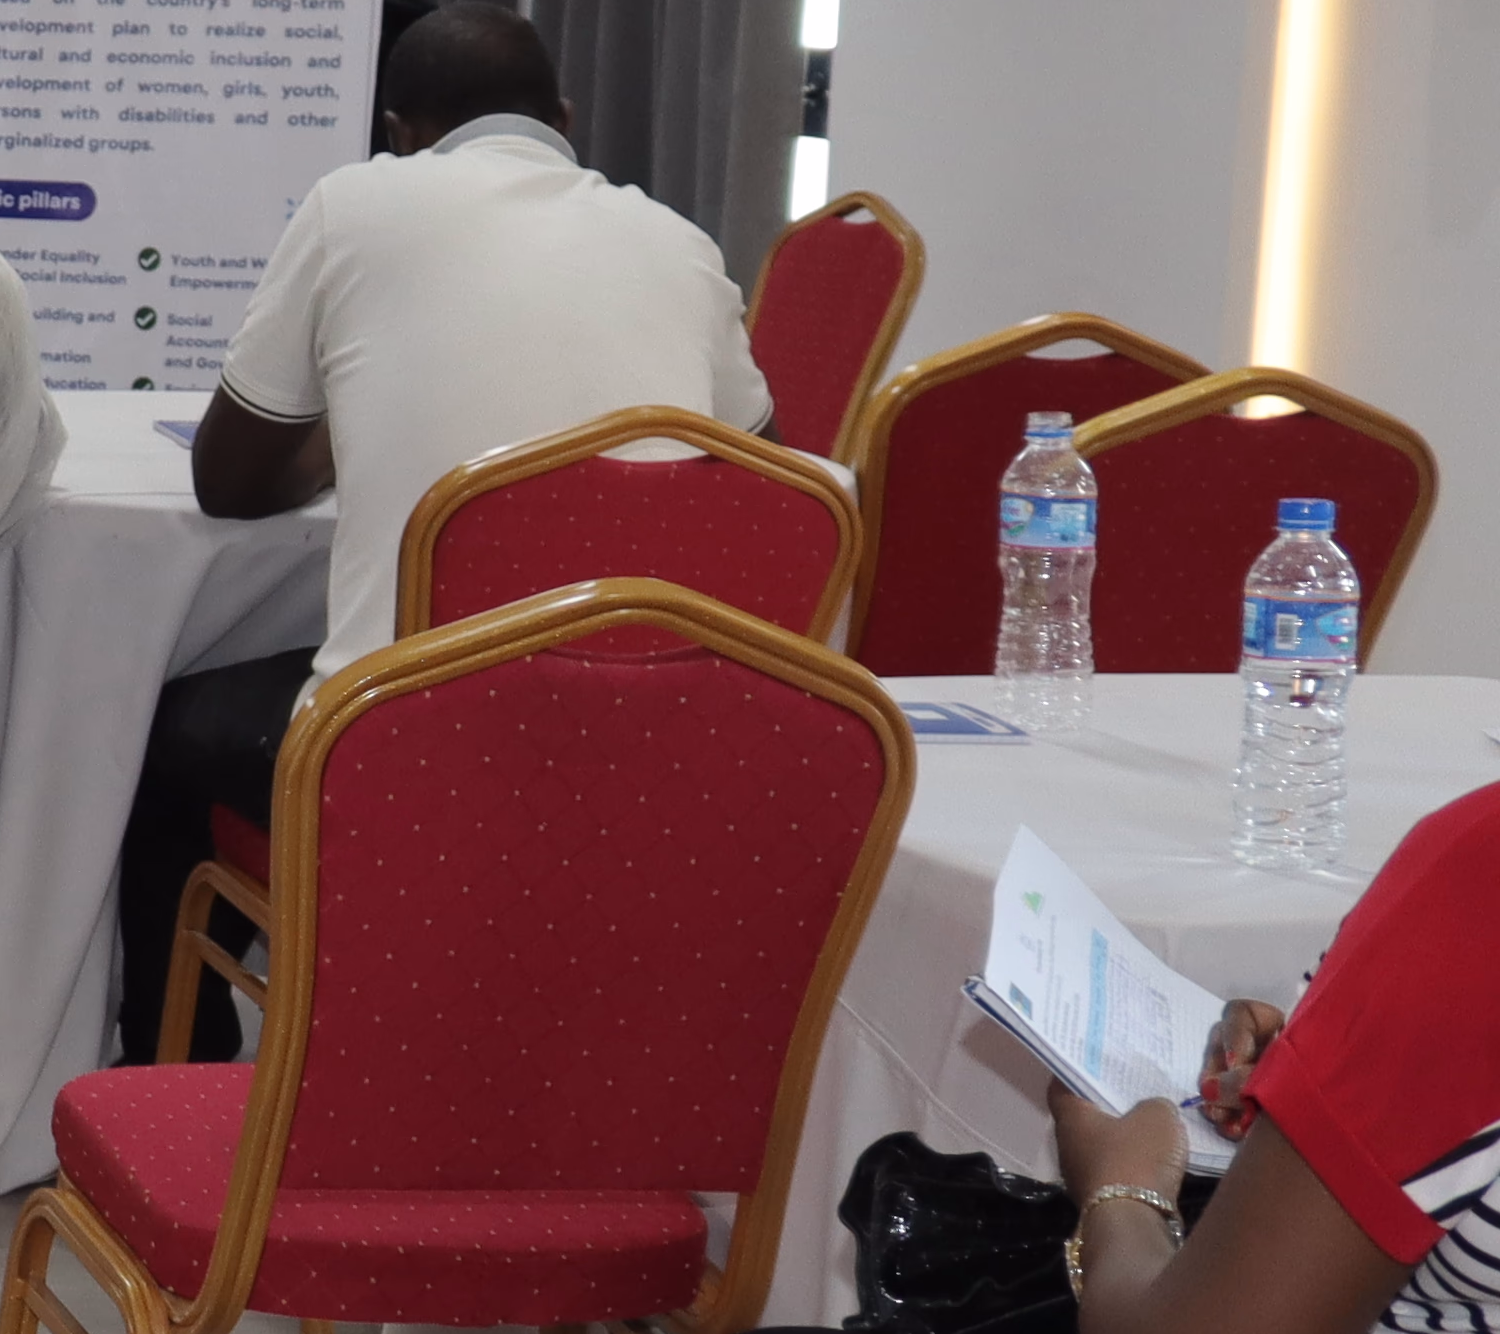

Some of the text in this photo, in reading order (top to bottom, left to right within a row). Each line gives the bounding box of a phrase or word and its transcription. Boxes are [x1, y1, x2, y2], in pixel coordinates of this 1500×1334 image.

[112, 18, 151, 38] plan
[169, 22, 188, 36] to
[206, 21, 267, 39] realize
[285, 23, 343, 41] social,
[58, 48, 93, 64] and
[106, 48, 195, 66] economic
[210, 49, 293, 68] inclusion
[307, 53, 342, 69] and
[105, 76, 125, 93] of
[137, 81, 209, 96] women,
[223, 79, 267, 99] girls,
[282, 82, 340, 100] youth,
[61, 105, 100, 121] with
[118, 105, 216, 125] disabilities
[234, 110, 269, 126] and
[287, 111, 338, 128] other
[88, 137, 154, 154] groups.
[18, 190, 81, 212] pillars
[40, 249, 100, 266] Equality
[172, 255, 247, 269] Youth and
[60, 270, 127, 285] Inclusion
[167, 313, 213, 327] Social
